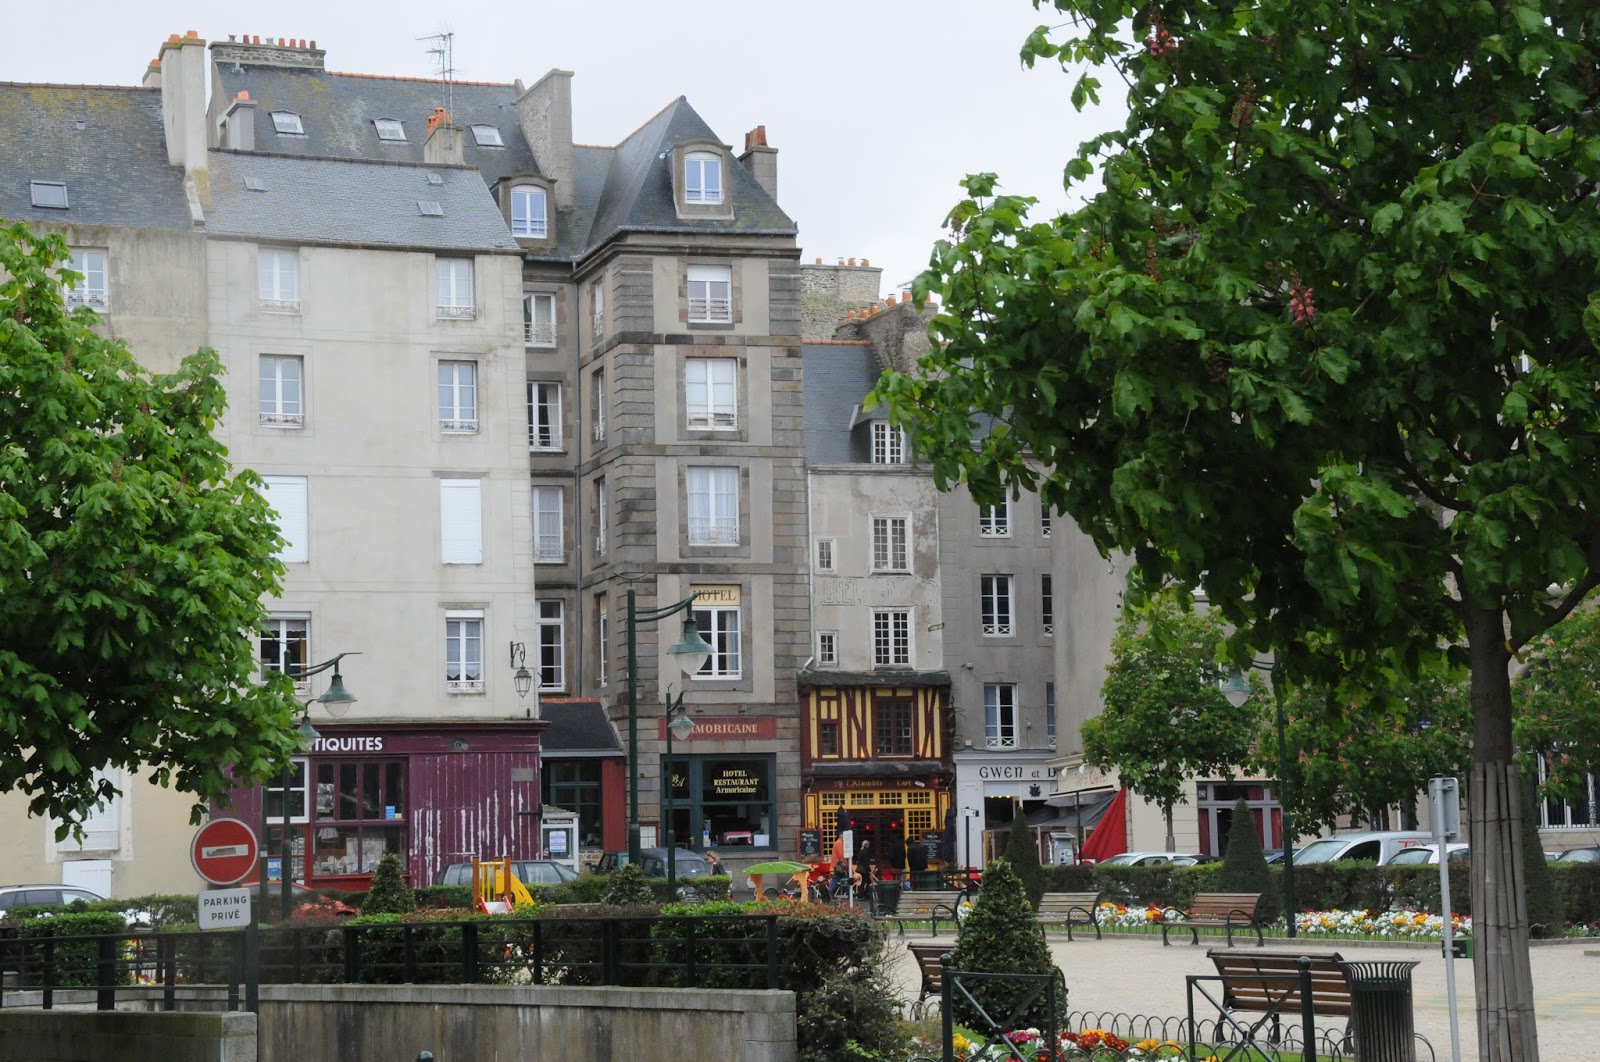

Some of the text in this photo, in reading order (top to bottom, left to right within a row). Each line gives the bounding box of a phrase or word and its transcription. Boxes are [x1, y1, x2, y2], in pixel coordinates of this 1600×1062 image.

[691, 724, 758, 734] MORICAINE
[314, 737, 383, 752] TIQUITES
[979, 766, 1023, 779] GWEN
[713, 778, 759, 786] RESTAURANT
[715, 786, 757, 794] Armoricaine
[203, 895, 247, 907] PARKING
[211, 908, 240, 920] PRIVÉ
